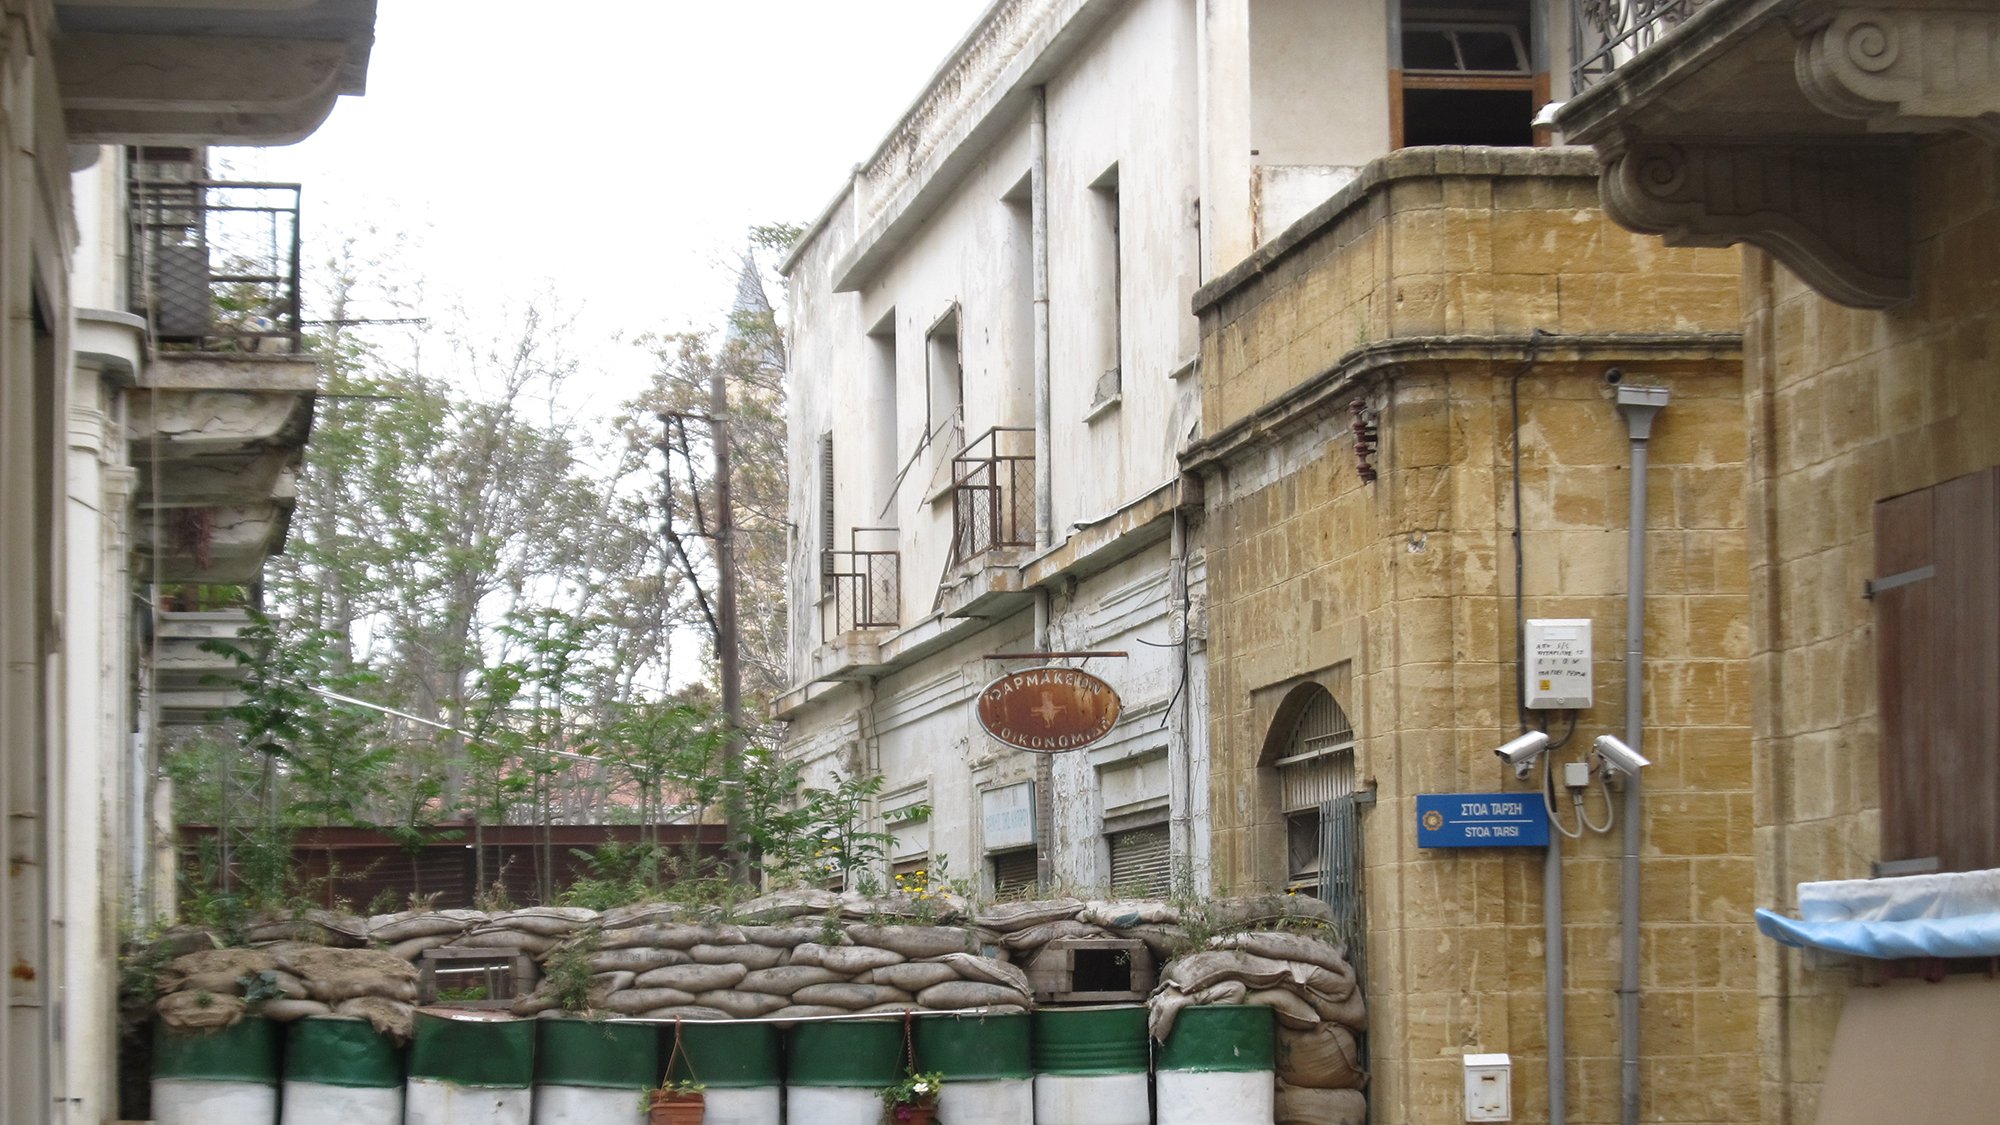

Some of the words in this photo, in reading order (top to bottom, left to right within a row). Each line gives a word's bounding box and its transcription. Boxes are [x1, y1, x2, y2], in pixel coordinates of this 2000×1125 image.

[1461, 803, 1488, 816] ΣΤΟΑ
[1490, 803, 1523, 815] ΤΑΡΣΗ
[1465, 827, 1490, 838] STOA
[1492, 826, 1519, 837] TARSI
